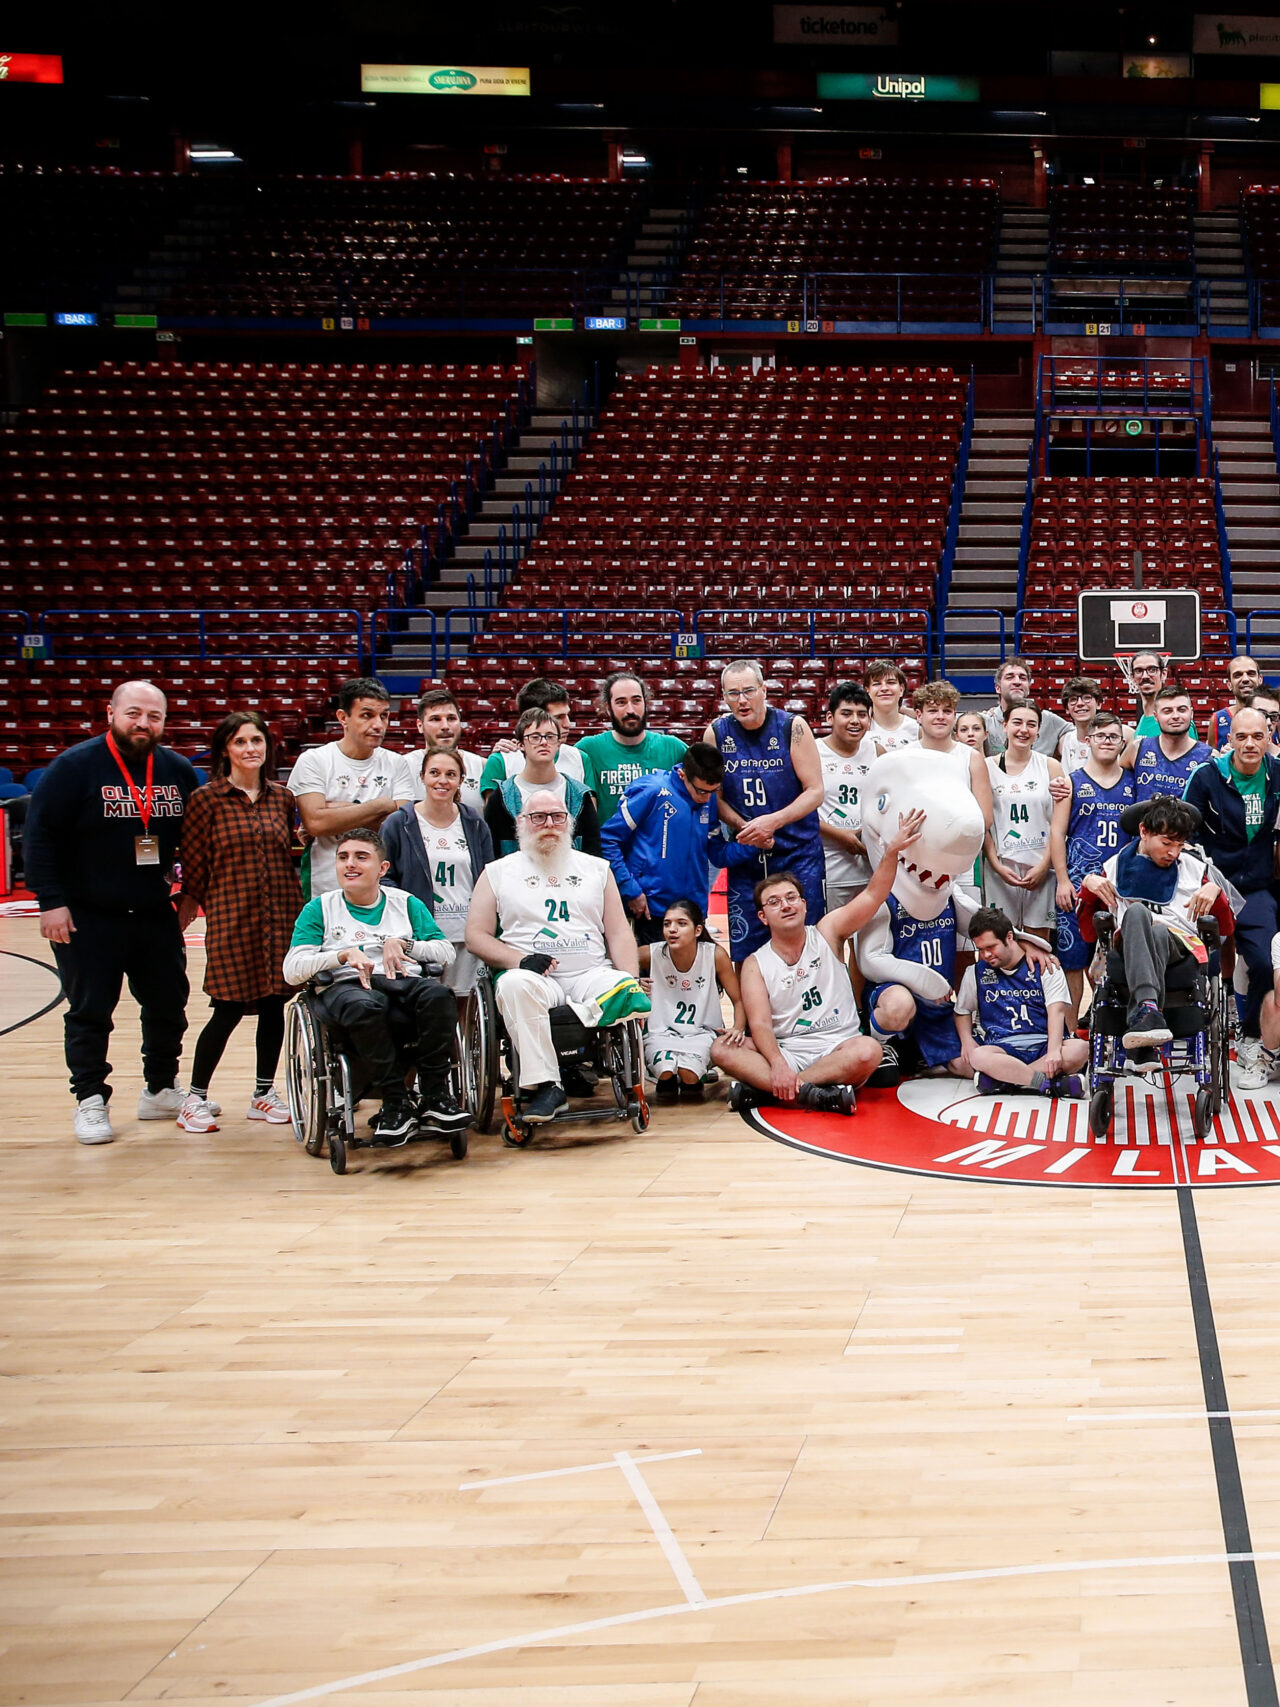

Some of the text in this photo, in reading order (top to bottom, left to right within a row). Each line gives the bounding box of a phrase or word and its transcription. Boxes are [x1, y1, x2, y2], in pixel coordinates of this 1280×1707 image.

[800, 17, 878, 35] ticketone
[877, 76, 925, 98] Unipol
[64, 314, 85, 325] BAR
[595, 319, 615, 329] BAR
[807, 322, 817, 331] 20
[1101, 325, 1110, 334] 21
[27, 637, 40, 645] 19
[680, 635, 694, 644] 20
[601, 768, 665, 786] FIREBA
[618, 763, 643, 771] POSAL
[102, 786, 182, 801] OLMPIA
[743, 778, 767, 807] 59
[838, 784, 858, 806] 33
[1010, 803, 1029, 825] 44
[1097, 820, 1118, 848] 26
[435, 861, 456, 887] 41
[545, 899, 570, 922] 24
[920, 937, 943, 967] 00
[802, 985, 823, 1011] 35
[676, 1001, 696, 1024] 22
[1005, 1004, 1035, 1030] 24
